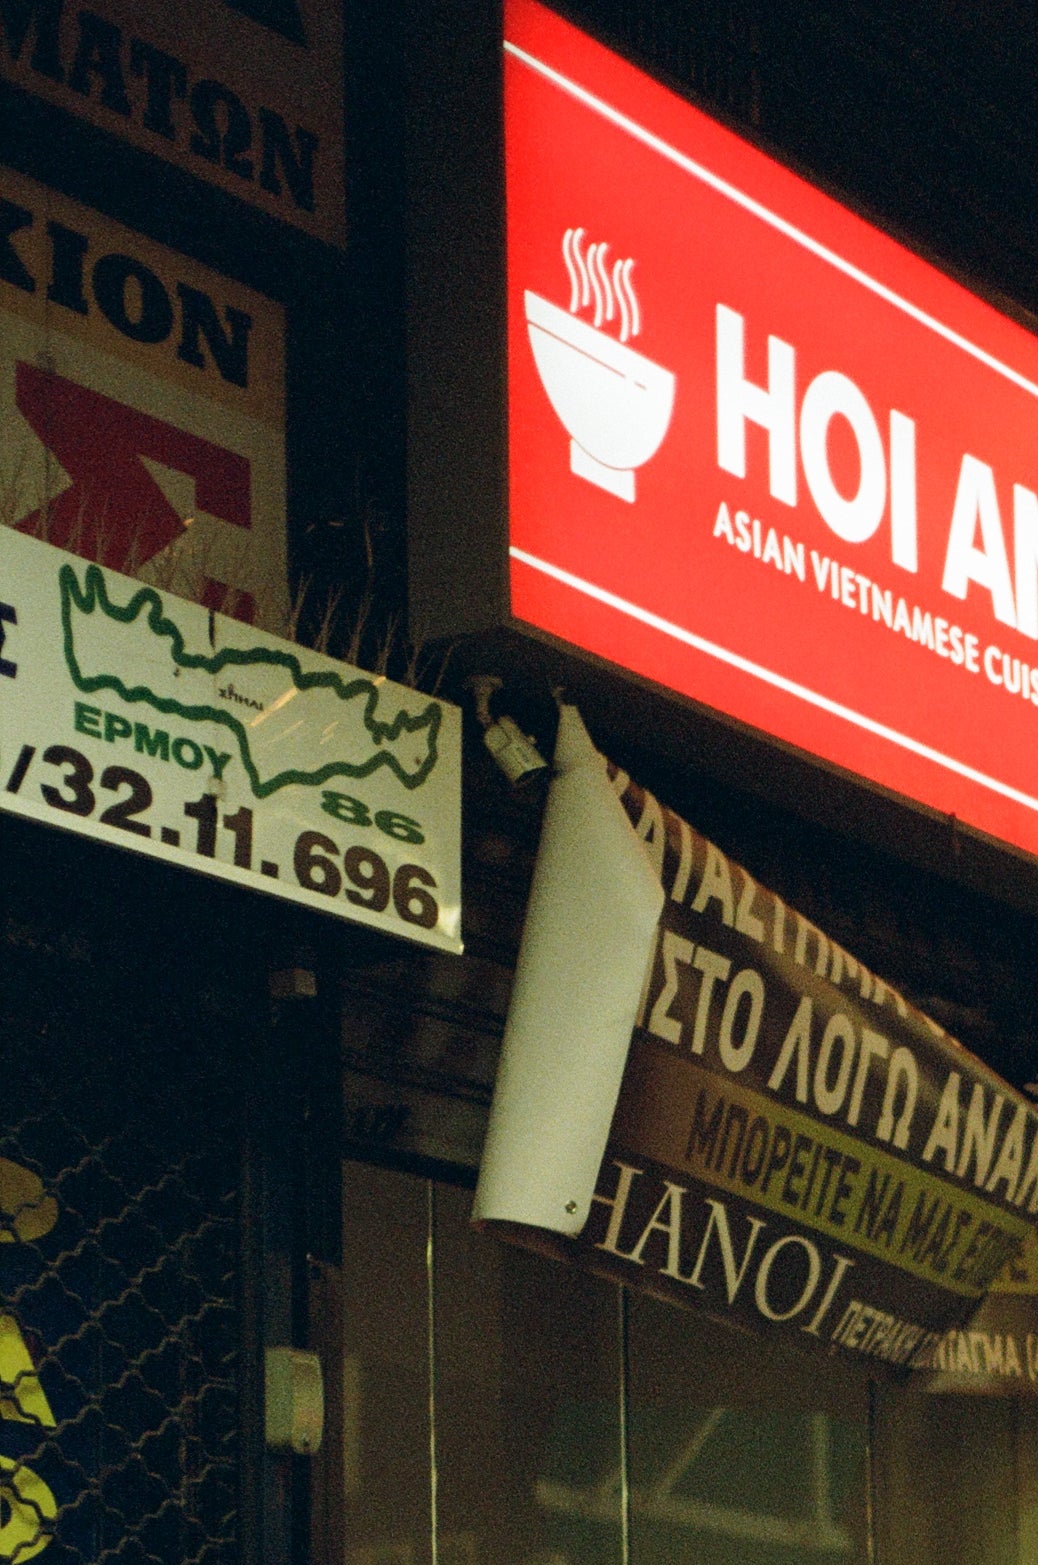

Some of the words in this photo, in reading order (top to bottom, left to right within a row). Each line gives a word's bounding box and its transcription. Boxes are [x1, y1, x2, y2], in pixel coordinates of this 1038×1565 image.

[715, 302, 918, 573] HOI
[713, 501, 805, 582] ASIAN
[810, 550, 980, 673] VIETNAMESE
[74, 700, 232, 780] ΕΡΜΟΥ
[321, 789, 425, 846] 86
[767, 996, 918, 1151] ΛΟΓΩ
[684, 1088, 861, 1227] ΜΠΟΡΕΙΤΕ
[853, 1164, 905, 1249] ΝΑ
